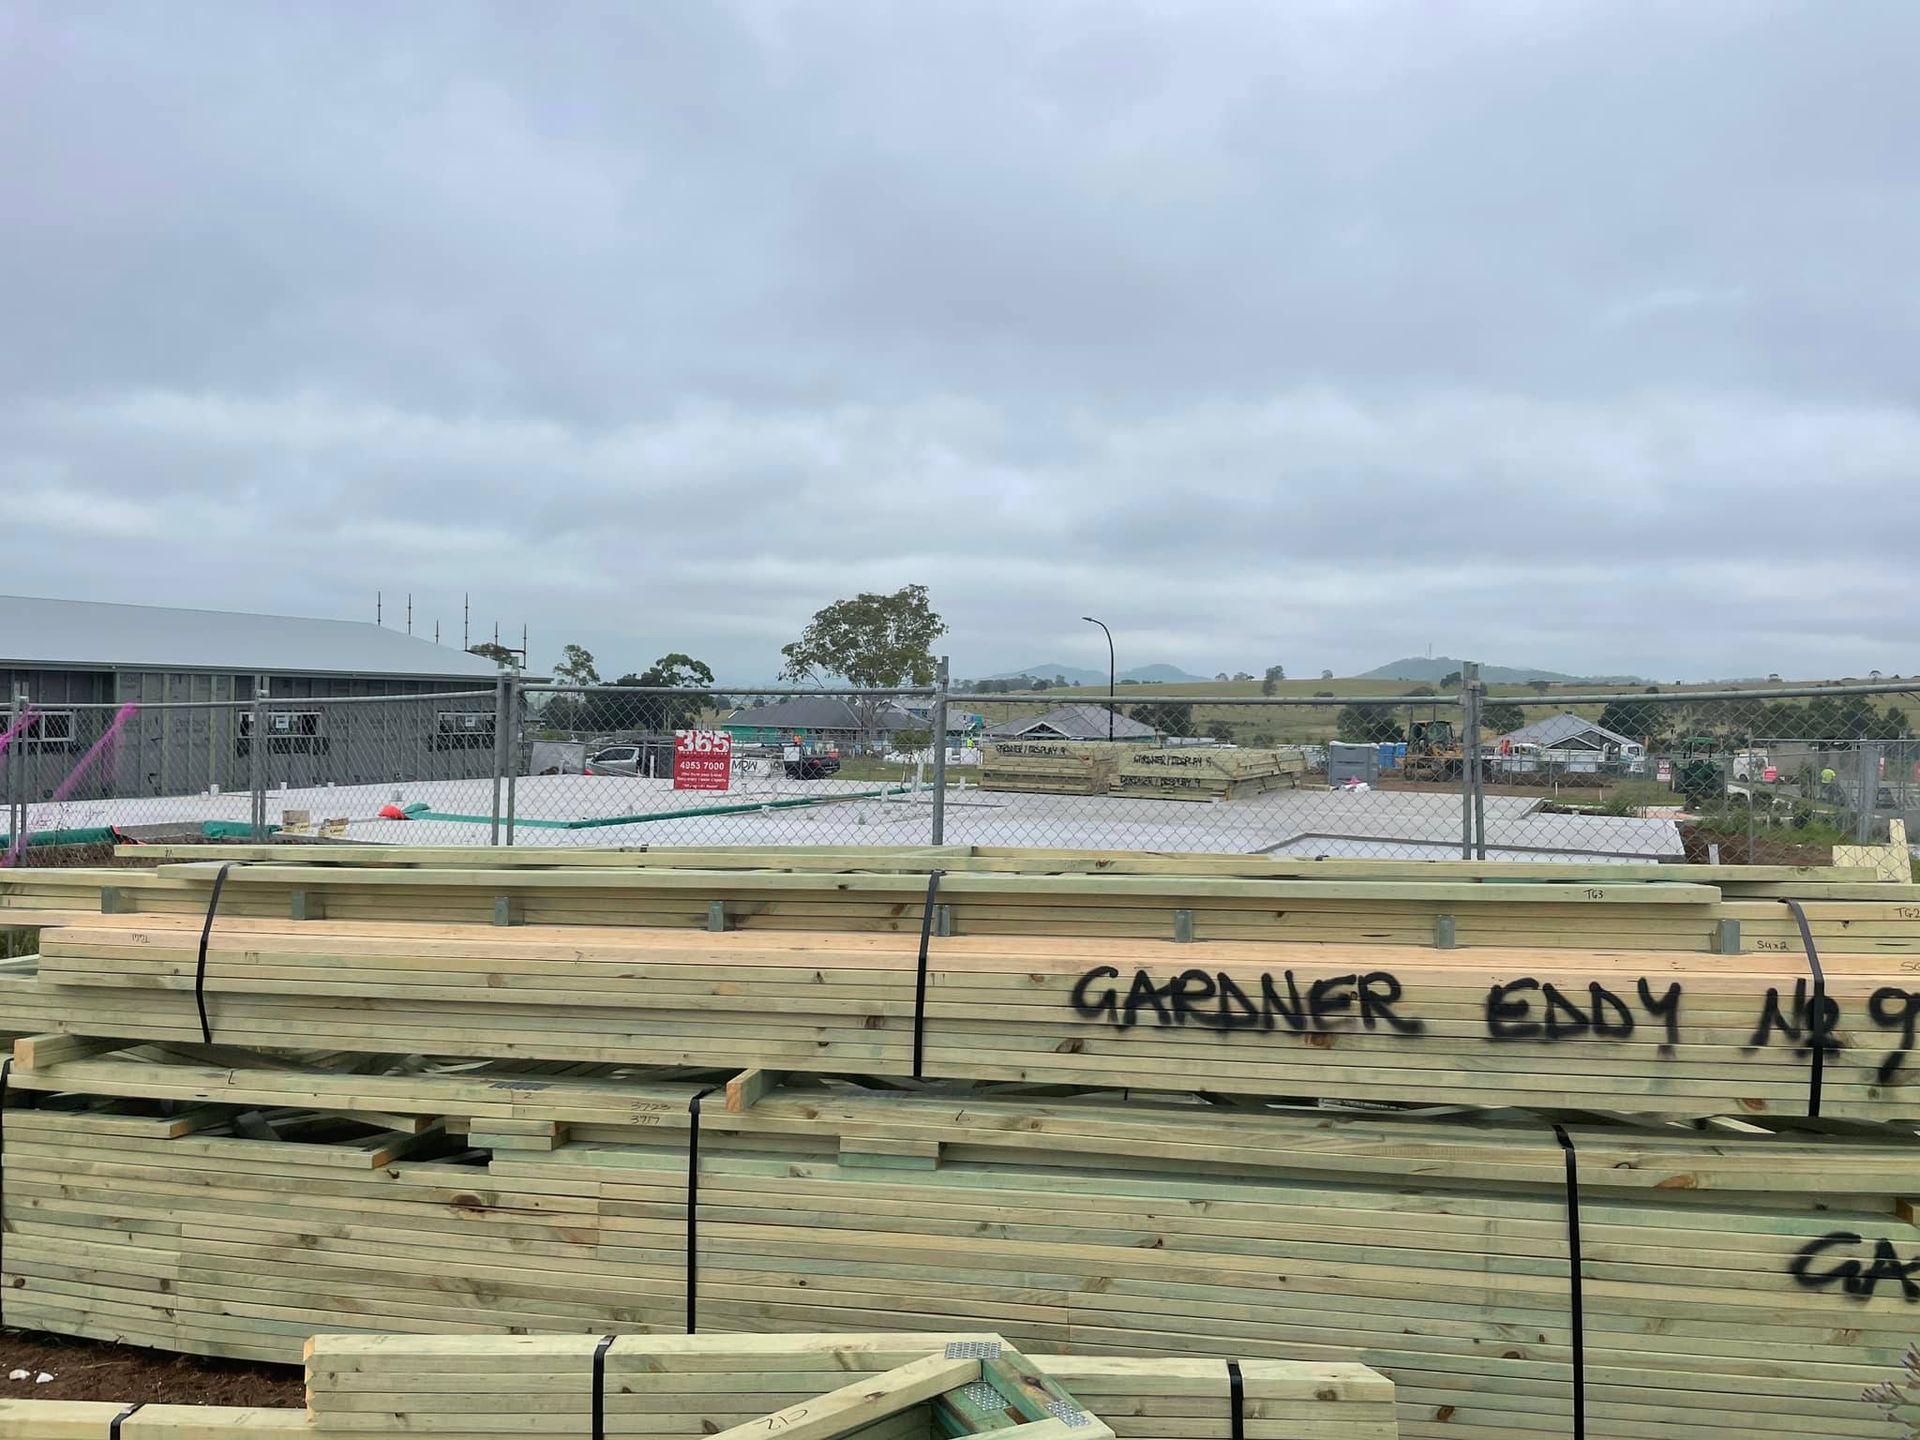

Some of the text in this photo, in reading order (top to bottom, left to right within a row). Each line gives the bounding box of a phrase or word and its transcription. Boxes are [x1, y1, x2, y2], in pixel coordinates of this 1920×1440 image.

[676, 730, 730, 752] 365
[680, 761, 725, 770] 4953 7000
[1072, 966, 1424, 1036] GARDNER
[1486, 976, 1682, 1055] EDDY
[1789, 1231, 1920, 1303] GA
